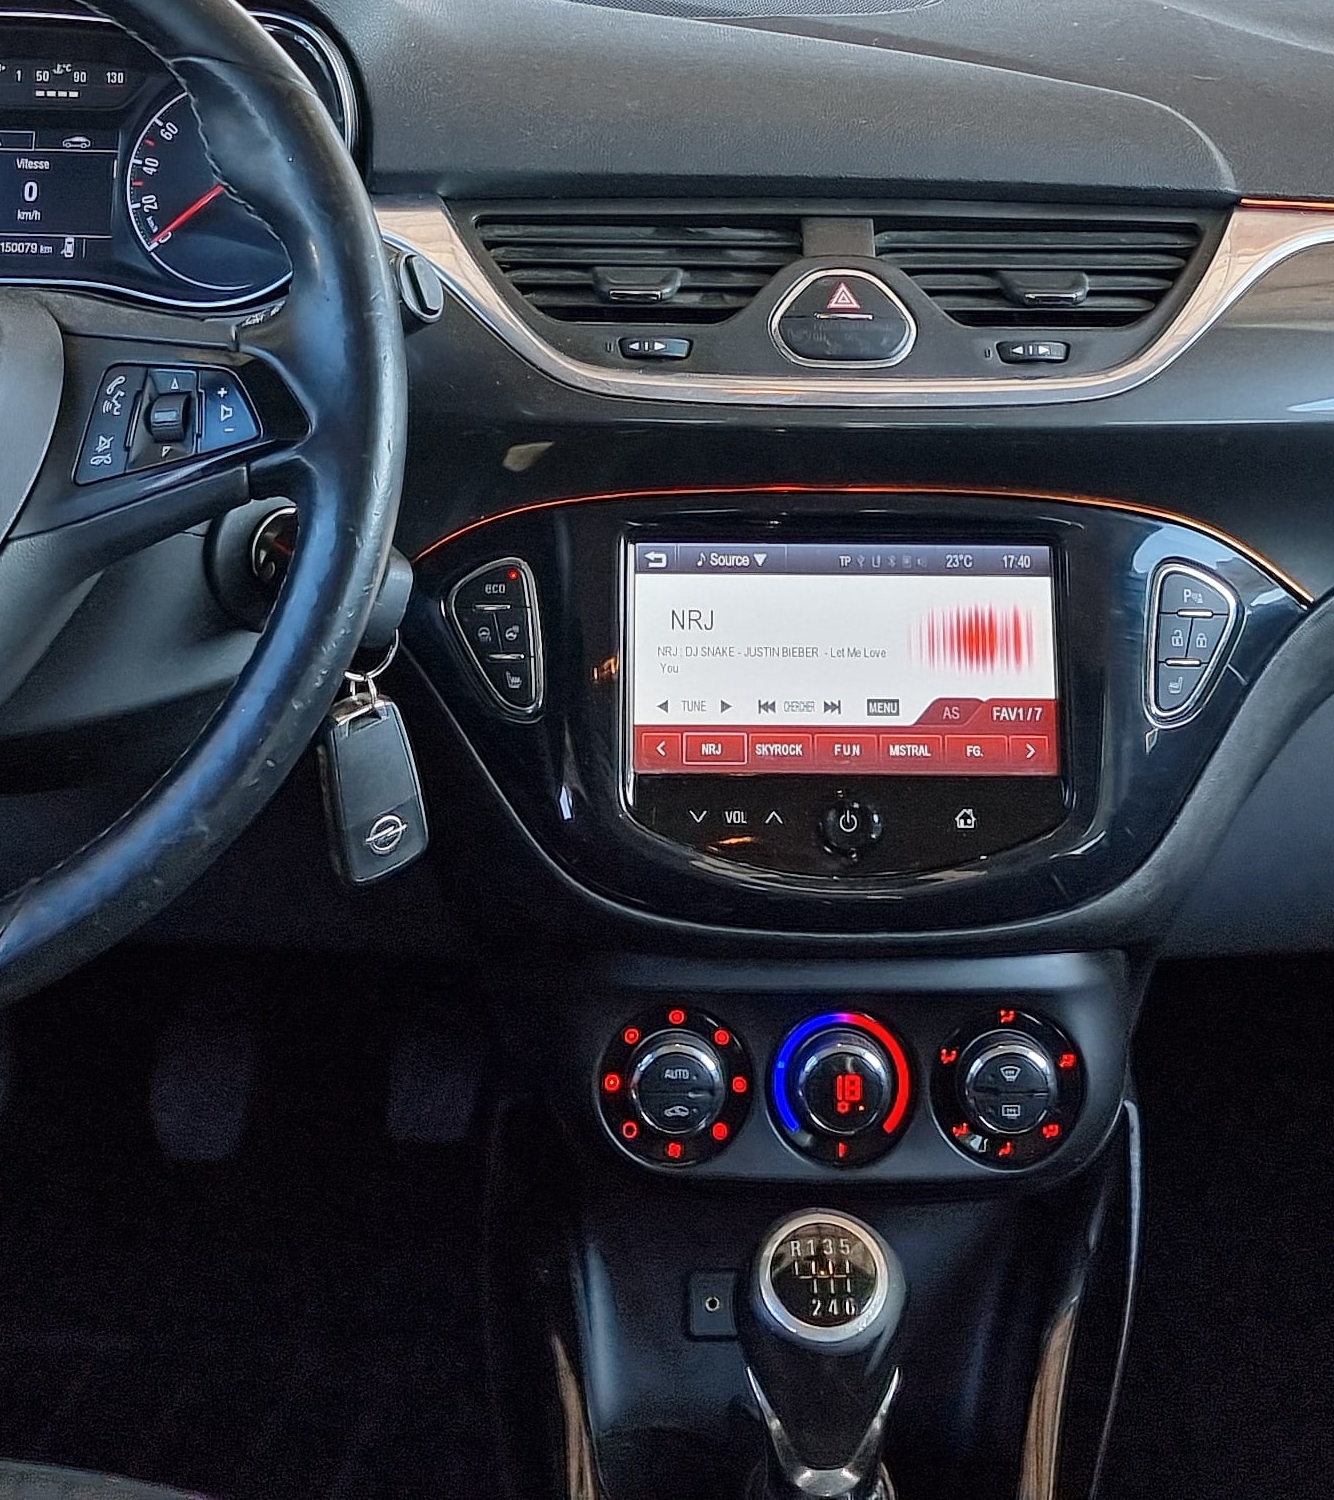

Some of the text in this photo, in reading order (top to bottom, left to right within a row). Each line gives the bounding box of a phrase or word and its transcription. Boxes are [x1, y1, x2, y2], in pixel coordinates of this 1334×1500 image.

[36, 70, 124, 84] 50 90 130
[160, 121, 179, 141] 60
[16, 157, 50, 170] Vitesse
[142, 157, 159, 175] 40
[24, 181, 38, 202] 0
[141, 194, 158, 213] 20
[17, 209, 41, 221] km/h
[0, 242, 53, 254] 150079 km
[709, 553, 750, 567] Source
[839, 555, 852, 567] TP
[946, 554, 973, 569] 23°C
[1002, 555, 1031, 569] 17:40
[671, 608, 715, 631] NRJ
[657, 646, 678, 657] NRJ
[685, 646, 700, 657] DJ
[701, 646, 735, 658] SNAKE
[743, 646, 779, 658] JUSTIN
[781, 646, 819, 658] BIEBER
[830, 647, 844, 658] Let
[847, 648, 862, 658] Me
[863, 648, 887, 659] Love
[660, 663, 679, 674] You
[681, 700, 707, 712] TUNE
[783, 700, 816, 713] CHERCHER
[869, 702, 898, 714] MENU
[942, 707, 960, 720] AS
[701, 743, 722, 756] NRJ
[755, 743, 803, 756] SKYROCK
[889, 744, 932, 757] MISTRAL
[966, 746, 984, 757] FG.
[724, 810, 748, 824] VOL
[664, 1068, 690, 1080] AUTO
[790, 1240, 802, 1257] R
[823, 1238, 833, 1255] 3
[840, 1238, 850, 1255] 5
[811, 1299, 822, 1316] 2
[828, 1299, 839, 1316] 4
